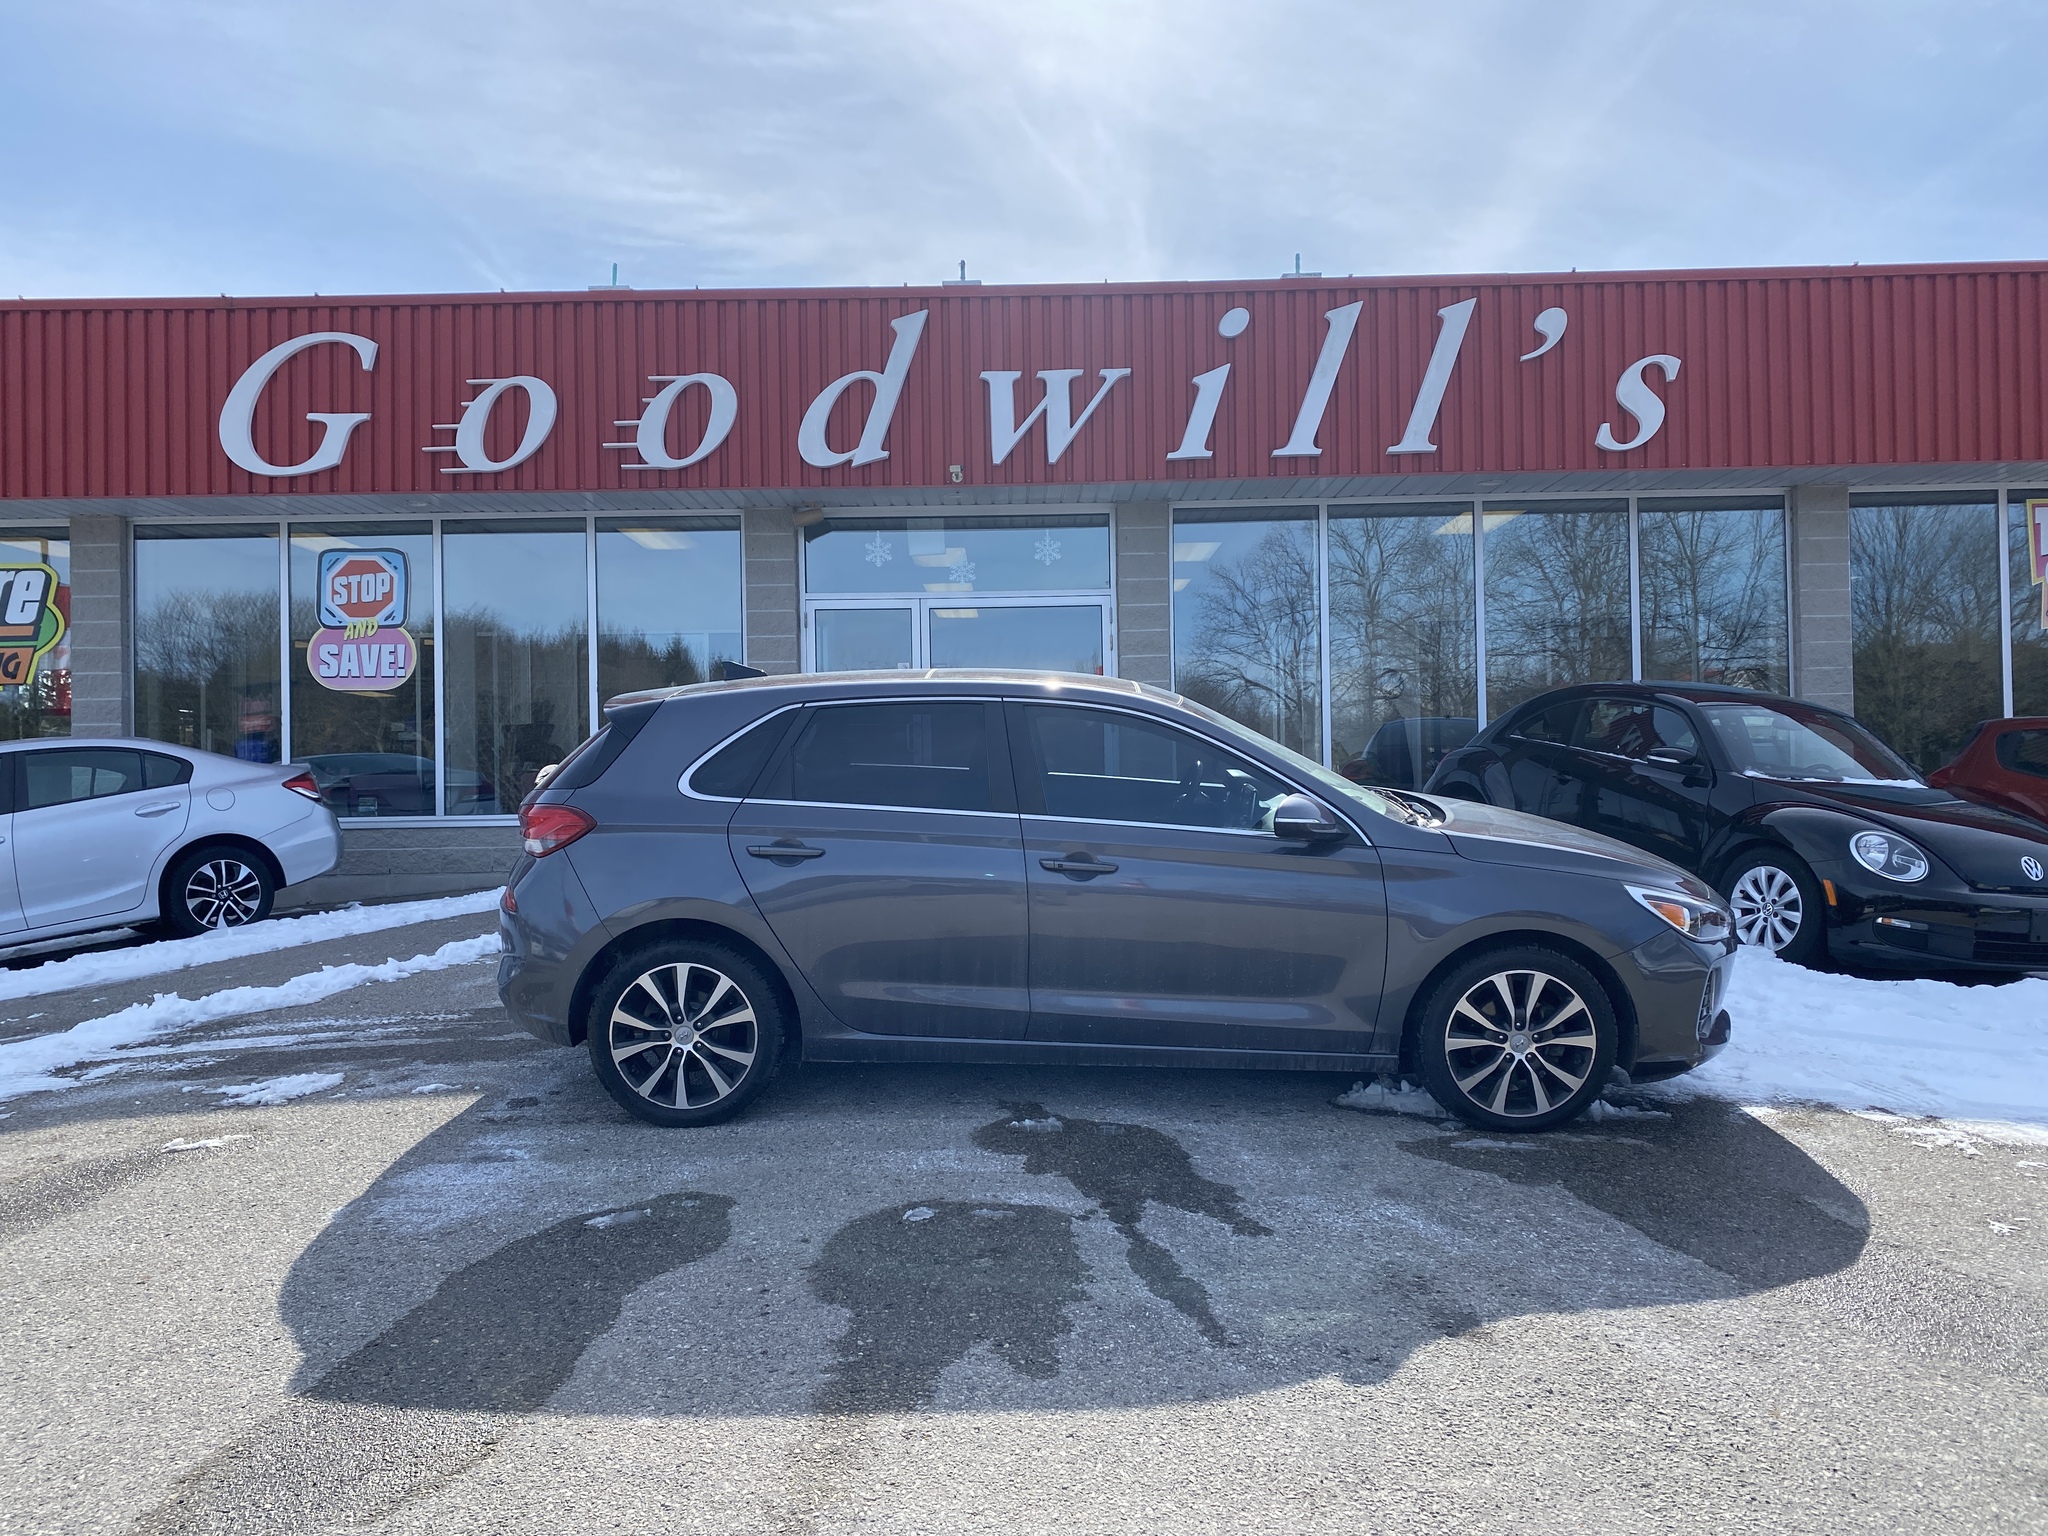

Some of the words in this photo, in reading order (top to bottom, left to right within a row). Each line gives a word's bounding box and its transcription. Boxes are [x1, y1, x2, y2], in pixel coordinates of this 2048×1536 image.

[218, 296, 1681, 477] Goodwill's
[333, 571, 391, 606] STOP
[344, 618, 379, 641] AND
[0, 651, 22, 680] G
[319, 643, 407, 678] SAVE!
